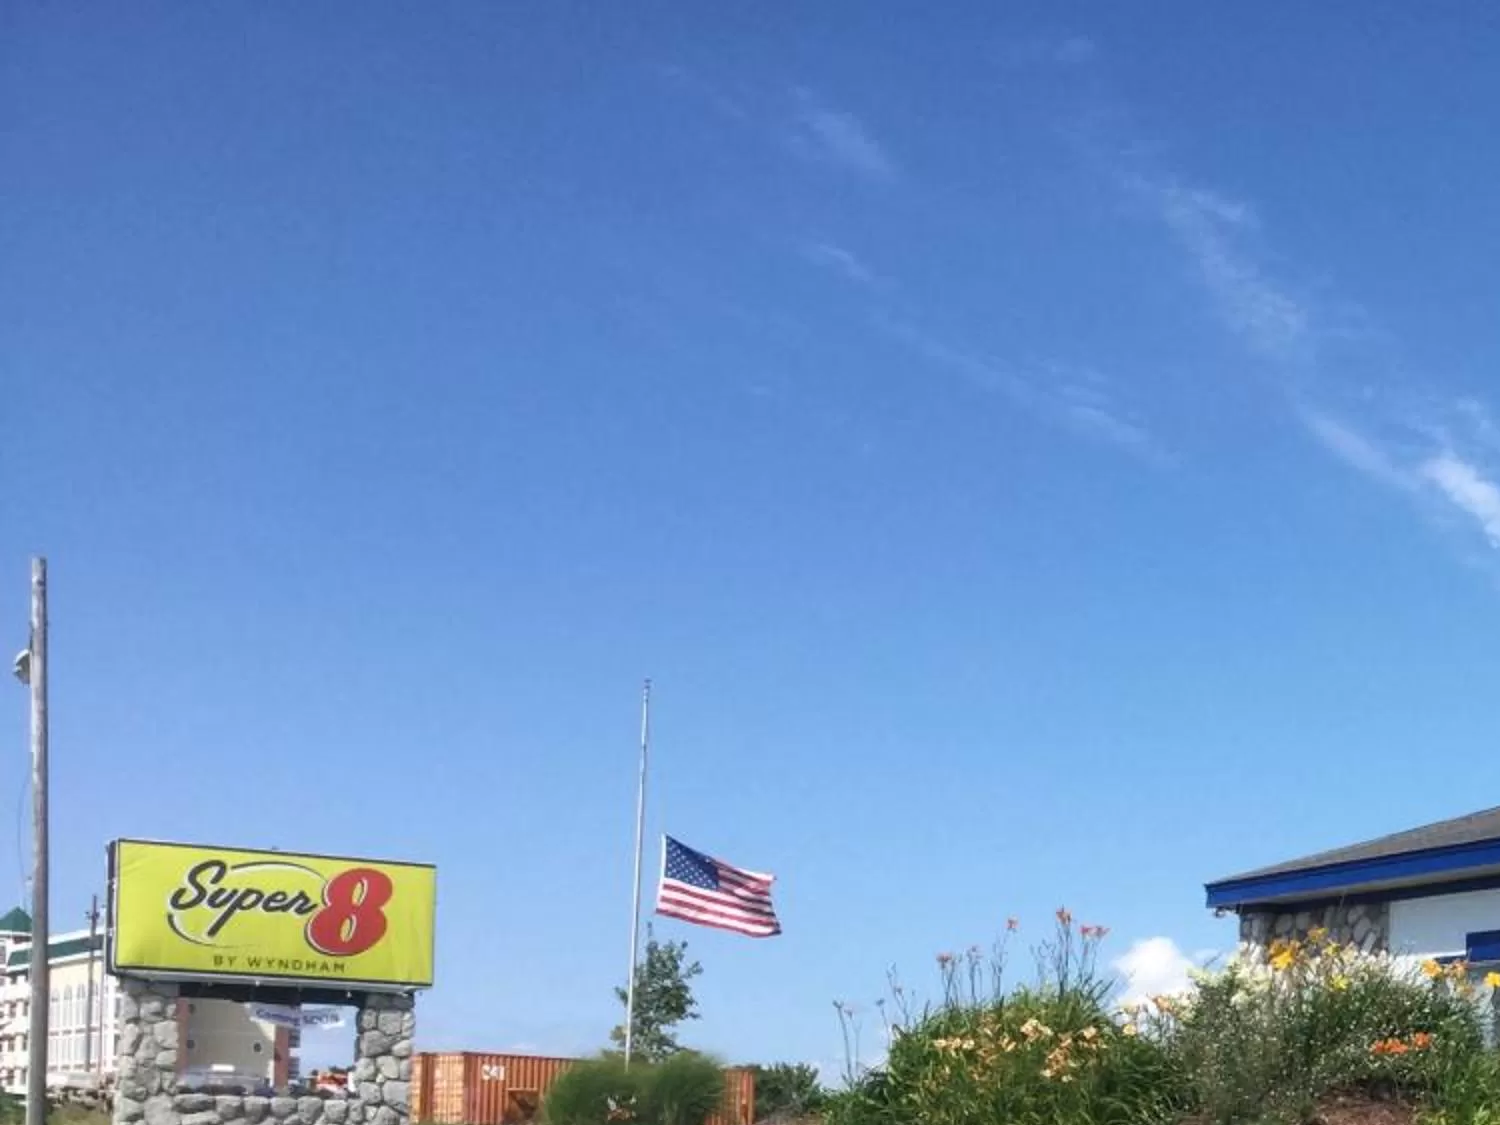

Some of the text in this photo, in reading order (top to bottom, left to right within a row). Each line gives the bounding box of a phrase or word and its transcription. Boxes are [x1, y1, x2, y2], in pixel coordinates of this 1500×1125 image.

[168, 859, 394, 957] Super 8
[213, 955, 346, 973] BY WYNDHAM
